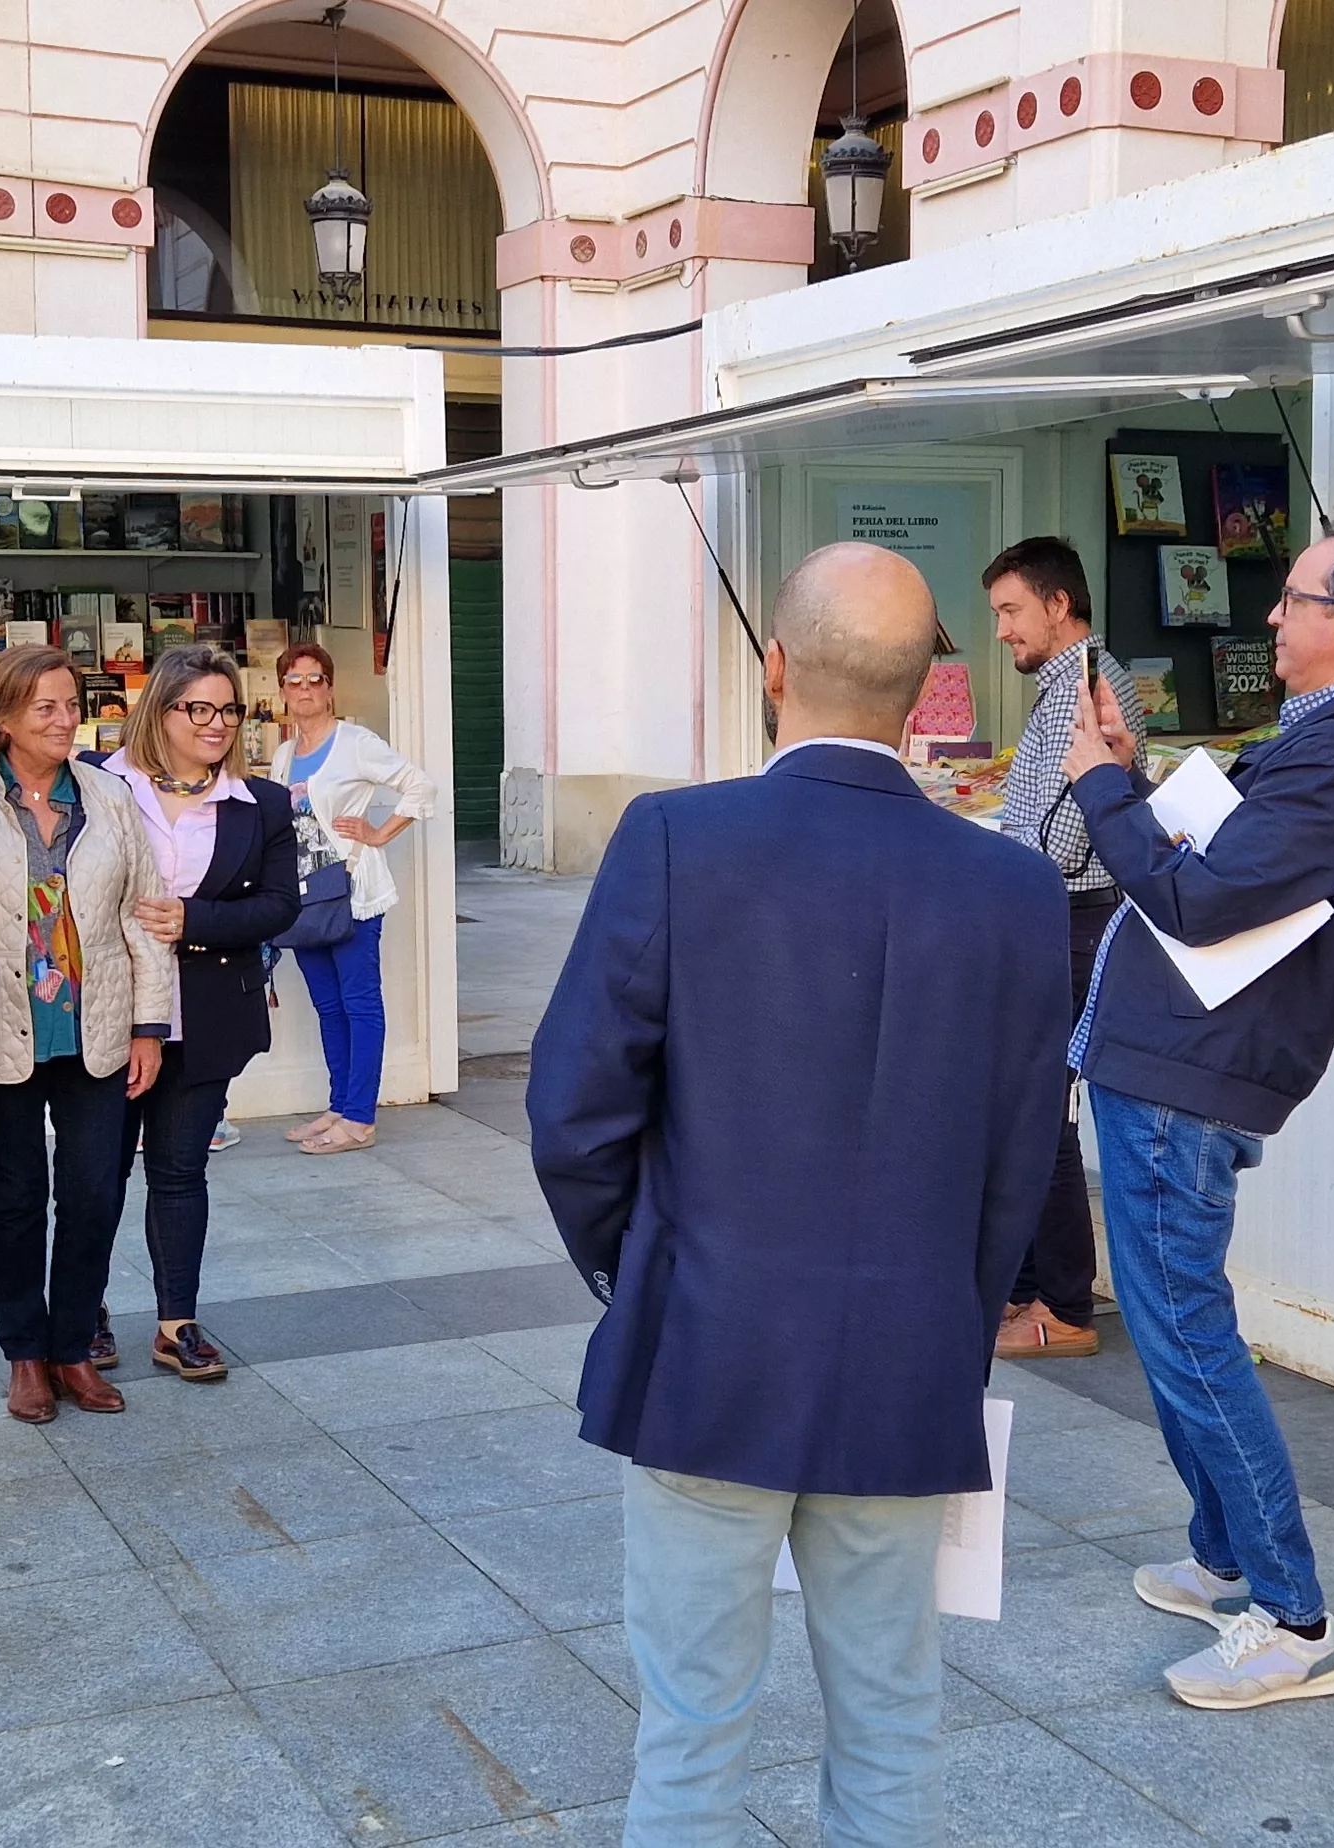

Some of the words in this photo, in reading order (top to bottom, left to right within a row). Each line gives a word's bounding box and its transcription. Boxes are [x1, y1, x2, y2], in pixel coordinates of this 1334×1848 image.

[852, 517, 883, 526] FERIA
[885, 517, 905, 526] DEL
[907, 517, 939, 526] LIBRO
[852, 529, 866, 538] DE
[868, 529, 909, 539] HUESCA
[1226, 643, 1267, 652] GUINNESS
[1226, 653, 1269, 664] WORLD
[1227, 665, 1270, 674] RECORDS
[1227, 674, 1270, 693] 2024
